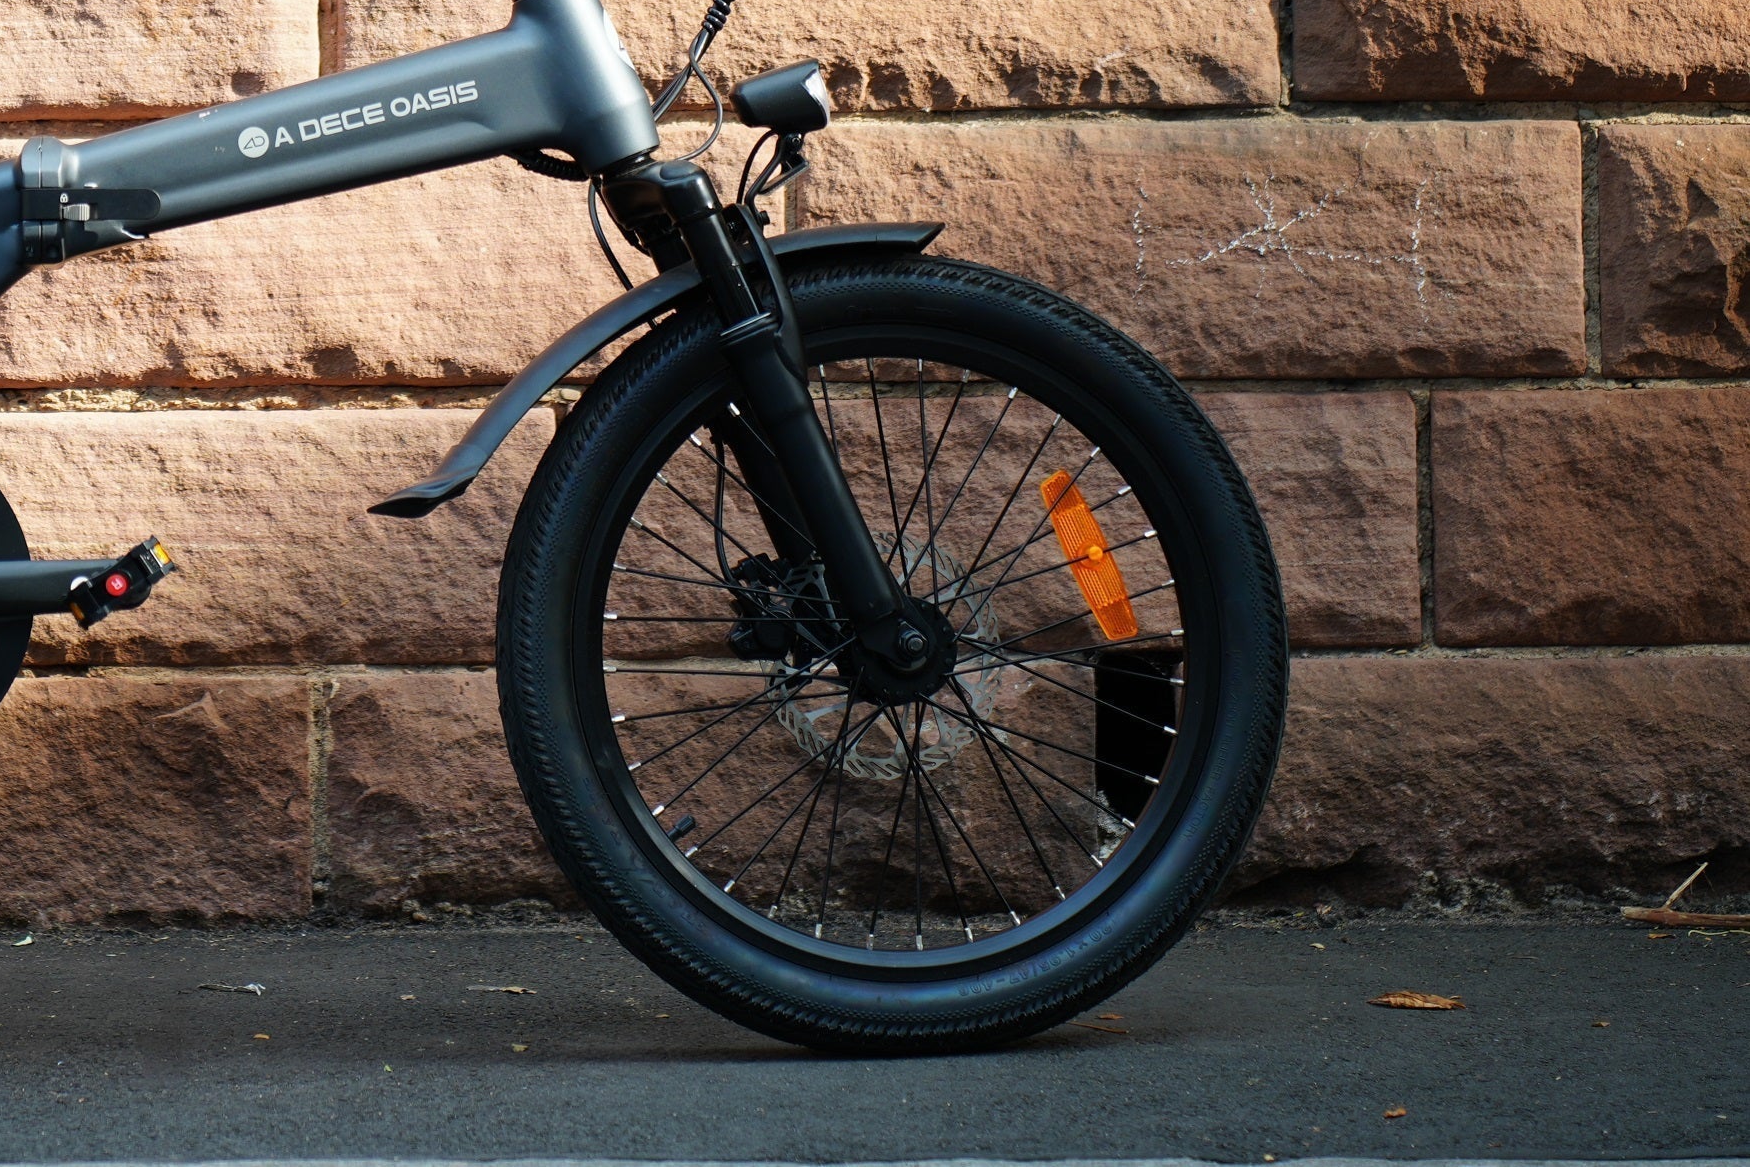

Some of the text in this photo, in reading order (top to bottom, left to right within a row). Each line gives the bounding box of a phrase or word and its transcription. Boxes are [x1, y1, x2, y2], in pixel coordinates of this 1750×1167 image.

[275, 126, 294, 148] A
[298, 102, 386, 142] DECE
[390, 80, 479, 118] OASIS
